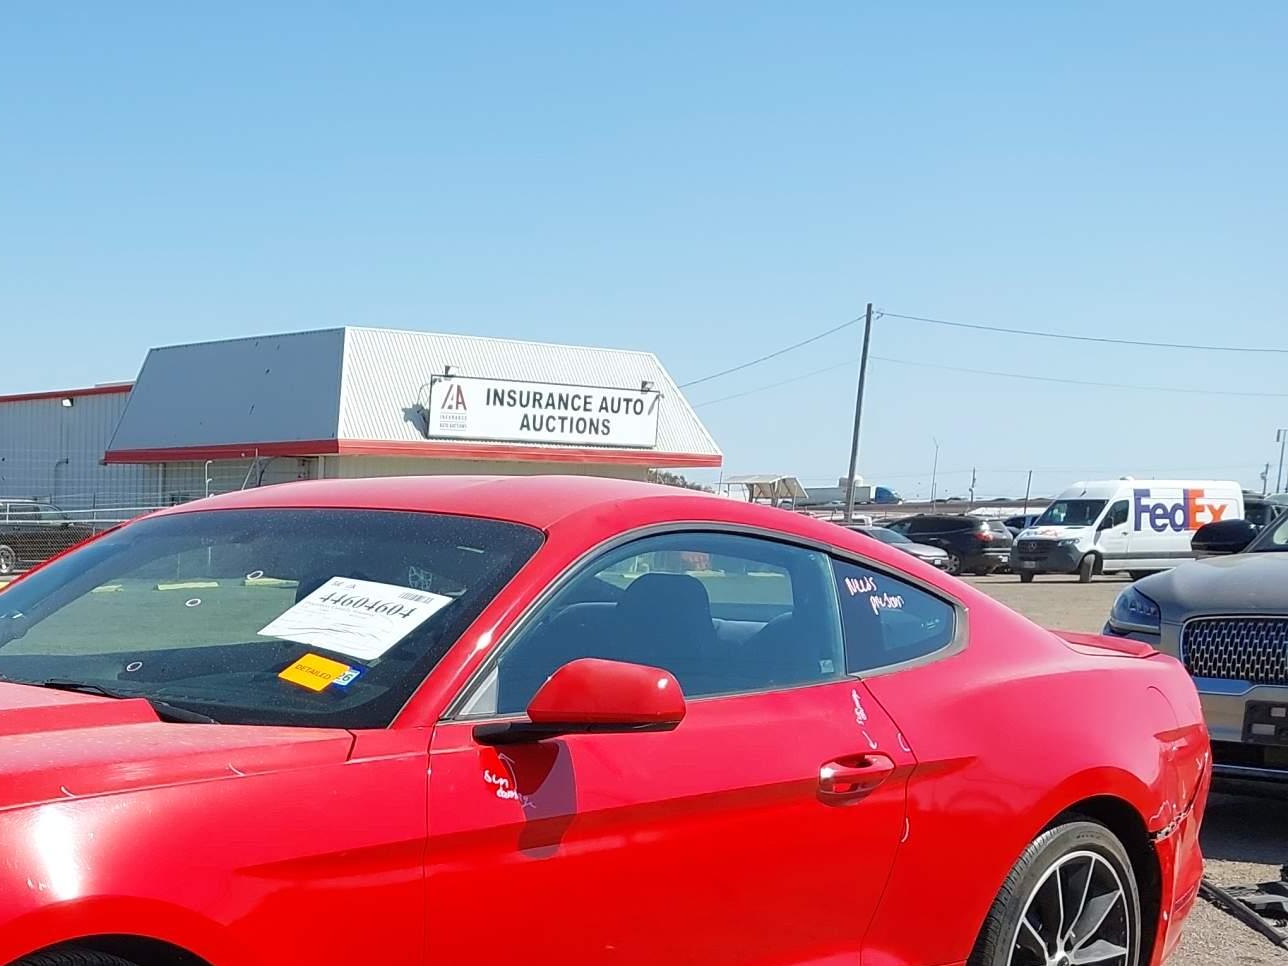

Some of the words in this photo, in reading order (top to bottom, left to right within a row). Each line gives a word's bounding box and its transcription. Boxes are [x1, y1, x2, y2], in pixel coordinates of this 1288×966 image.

[486, 388, 592, 412] INSURANCE
[598, 396, 644, 415] AUTO
[519, 413, 610, 436] AUCTIONS
[1133, 488, 1227, 532] FedEx
[320, 591, 417, 619] 44604604
[295, 664, 332, 681] DETAILED
